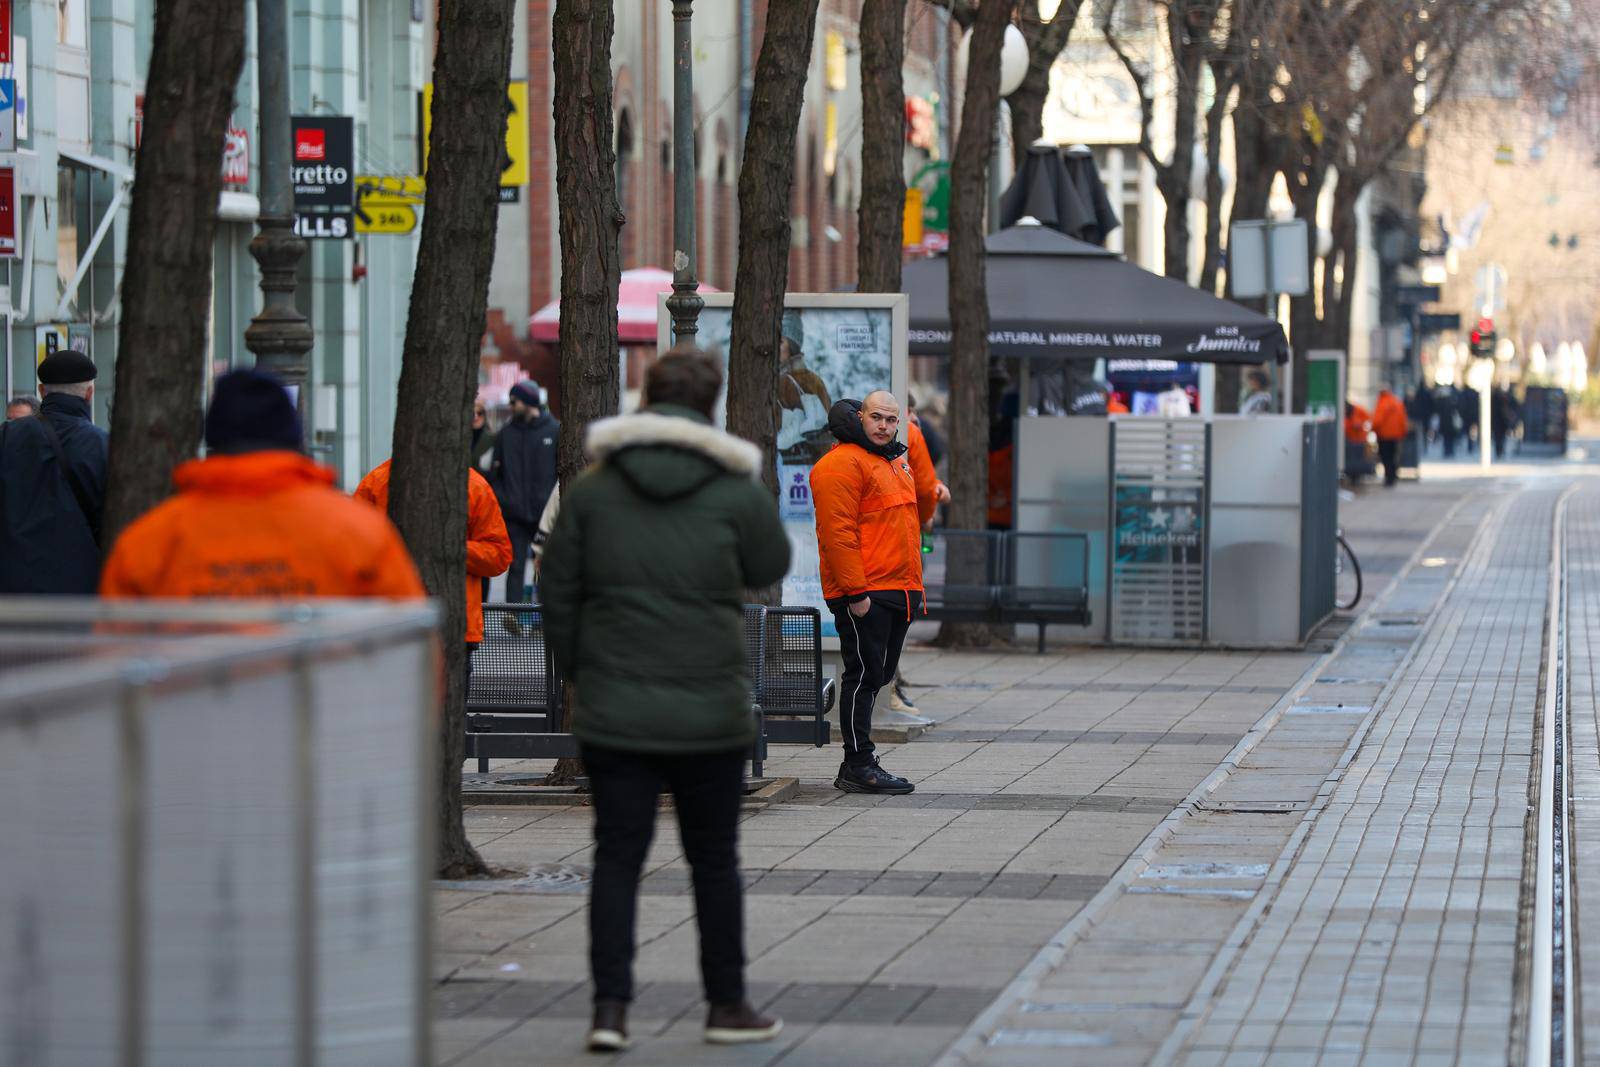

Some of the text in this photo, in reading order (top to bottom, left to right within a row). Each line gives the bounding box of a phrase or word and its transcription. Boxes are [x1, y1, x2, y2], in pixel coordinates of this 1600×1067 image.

[987, 331, 1047, 345] NATURAL
[1048, 332, 1111, 346] MINERAL
[1112, 333, 1162, 347] WATER
[1186, 334, 1260, 353] Jamnica
[1121, 531, 1197, 545] Heineken
